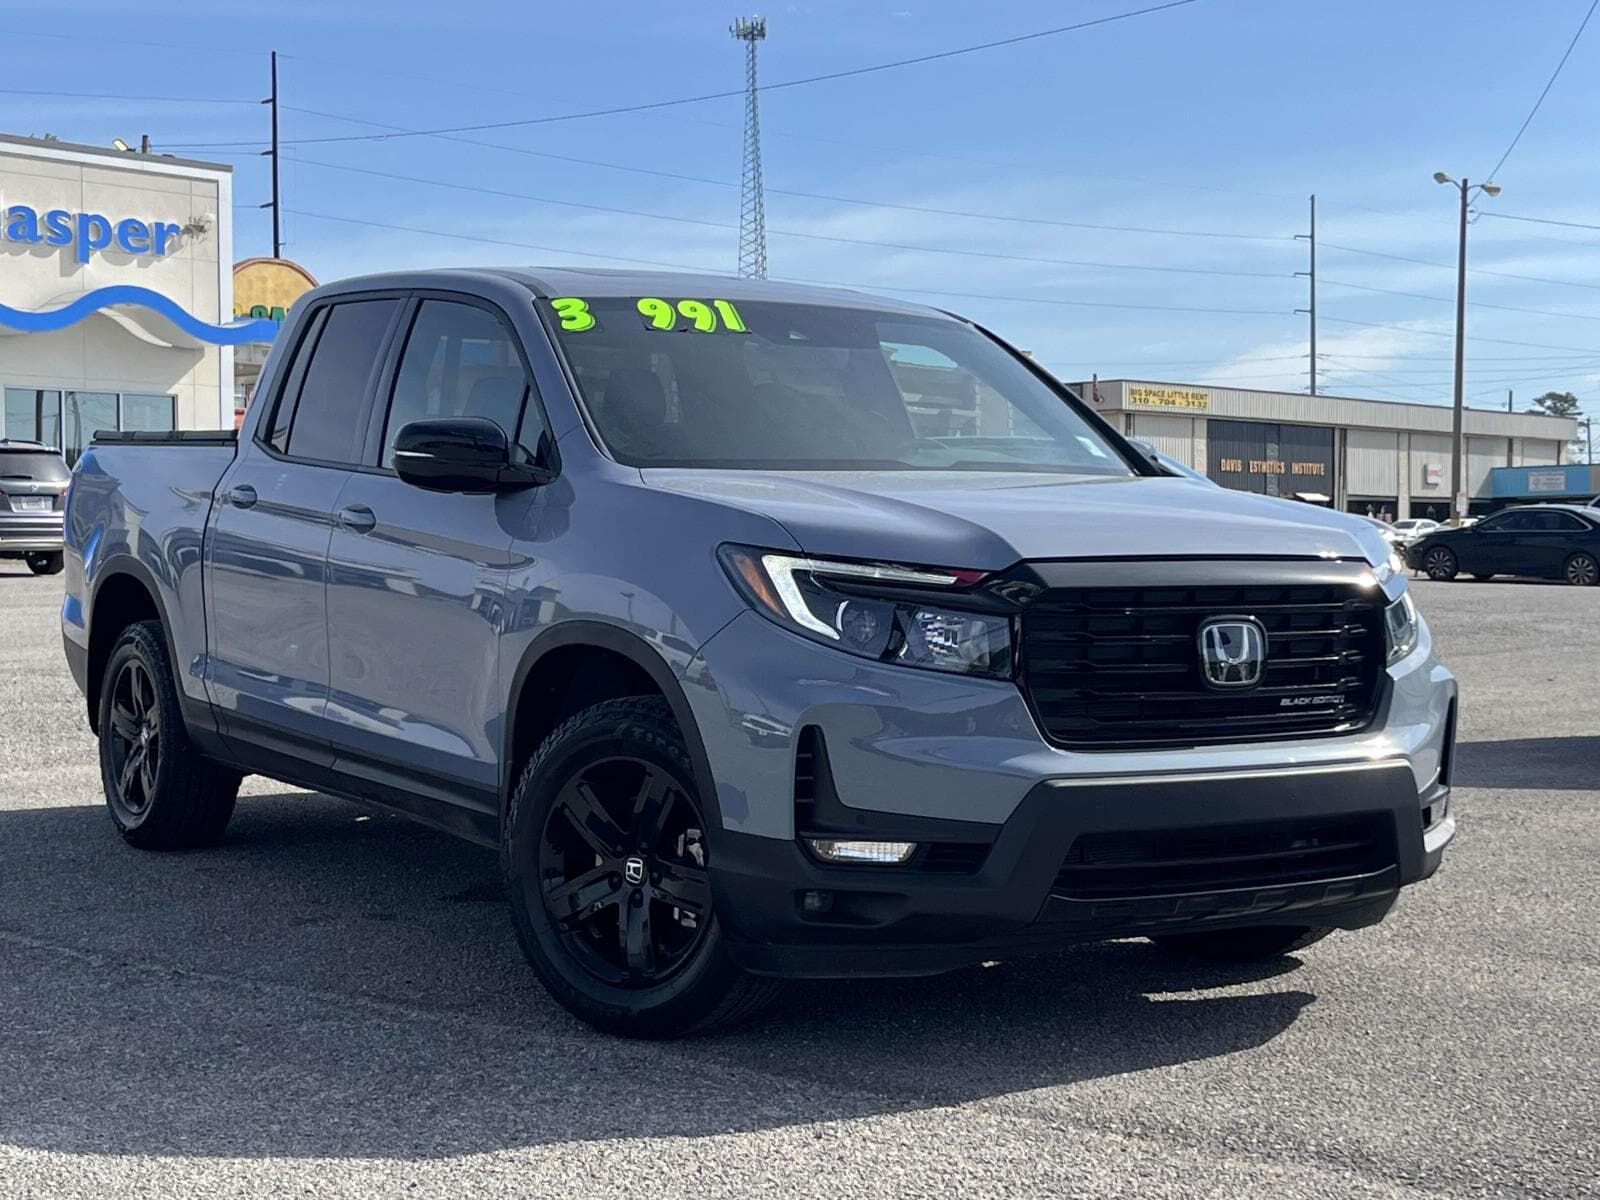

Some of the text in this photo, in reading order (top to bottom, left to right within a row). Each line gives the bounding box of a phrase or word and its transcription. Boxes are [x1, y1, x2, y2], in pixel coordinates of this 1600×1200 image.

[0, 205, 180, 264] asper
[551, 297, 747, 333] 3 991
[1130, 388, 1209, 401] BIG SPACE LITTLE RENT
[1221, 459, 1242, 472] DAVIS
[1292, 462, 1325, 476] INSTITUTE
[1280, 697, 1312, 706] BLACK
